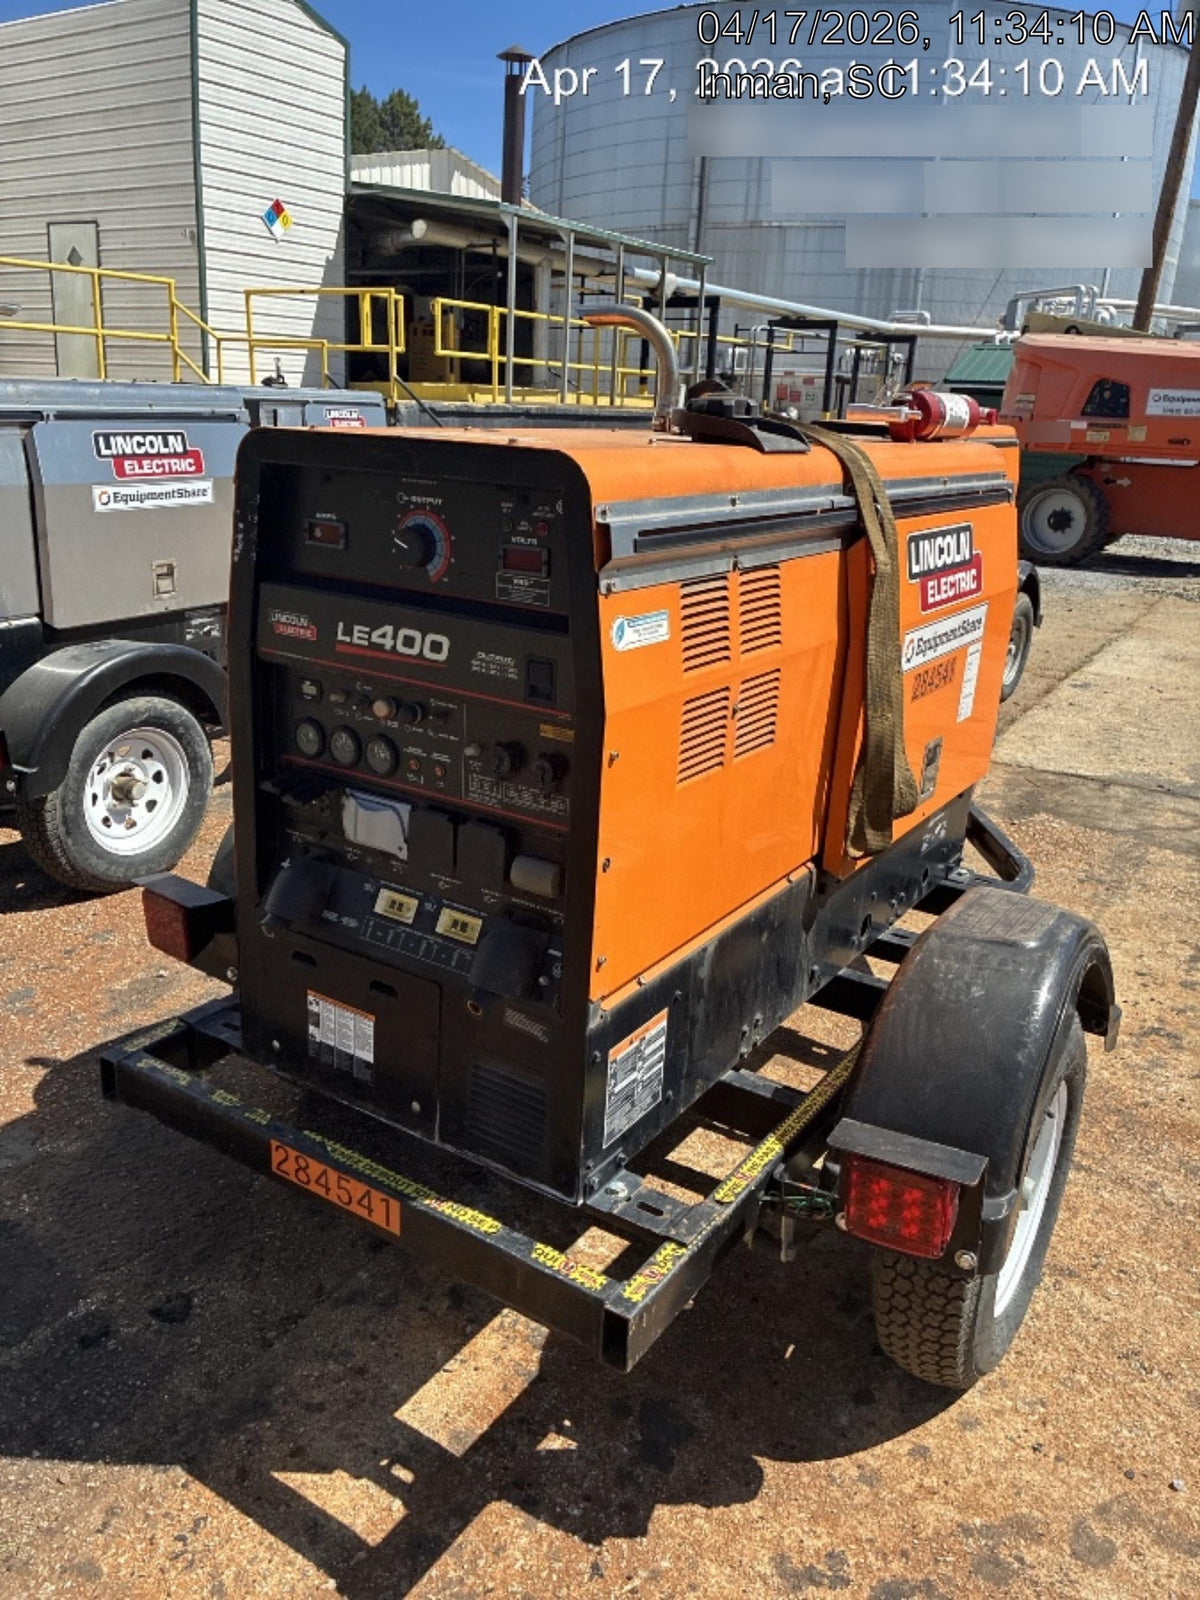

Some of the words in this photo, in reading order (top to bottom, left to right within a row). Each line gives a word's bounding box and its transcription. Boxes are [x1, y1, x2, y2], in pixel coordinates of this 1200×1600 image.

[98, 433, 183, 455] LINCOLN
[124, 457, 196, 475] ELECTRIC
[112, 486, 209, 504] EquipmentShare
[911, 530, 970, 574] LINCOLN
[927, 568, 977, 605] ELECTRIC
[336, 621, 450, 662] LE400
[914, 616, 983, 658] EquipmentShare
[274, 1144, 391, 1228] 284541
